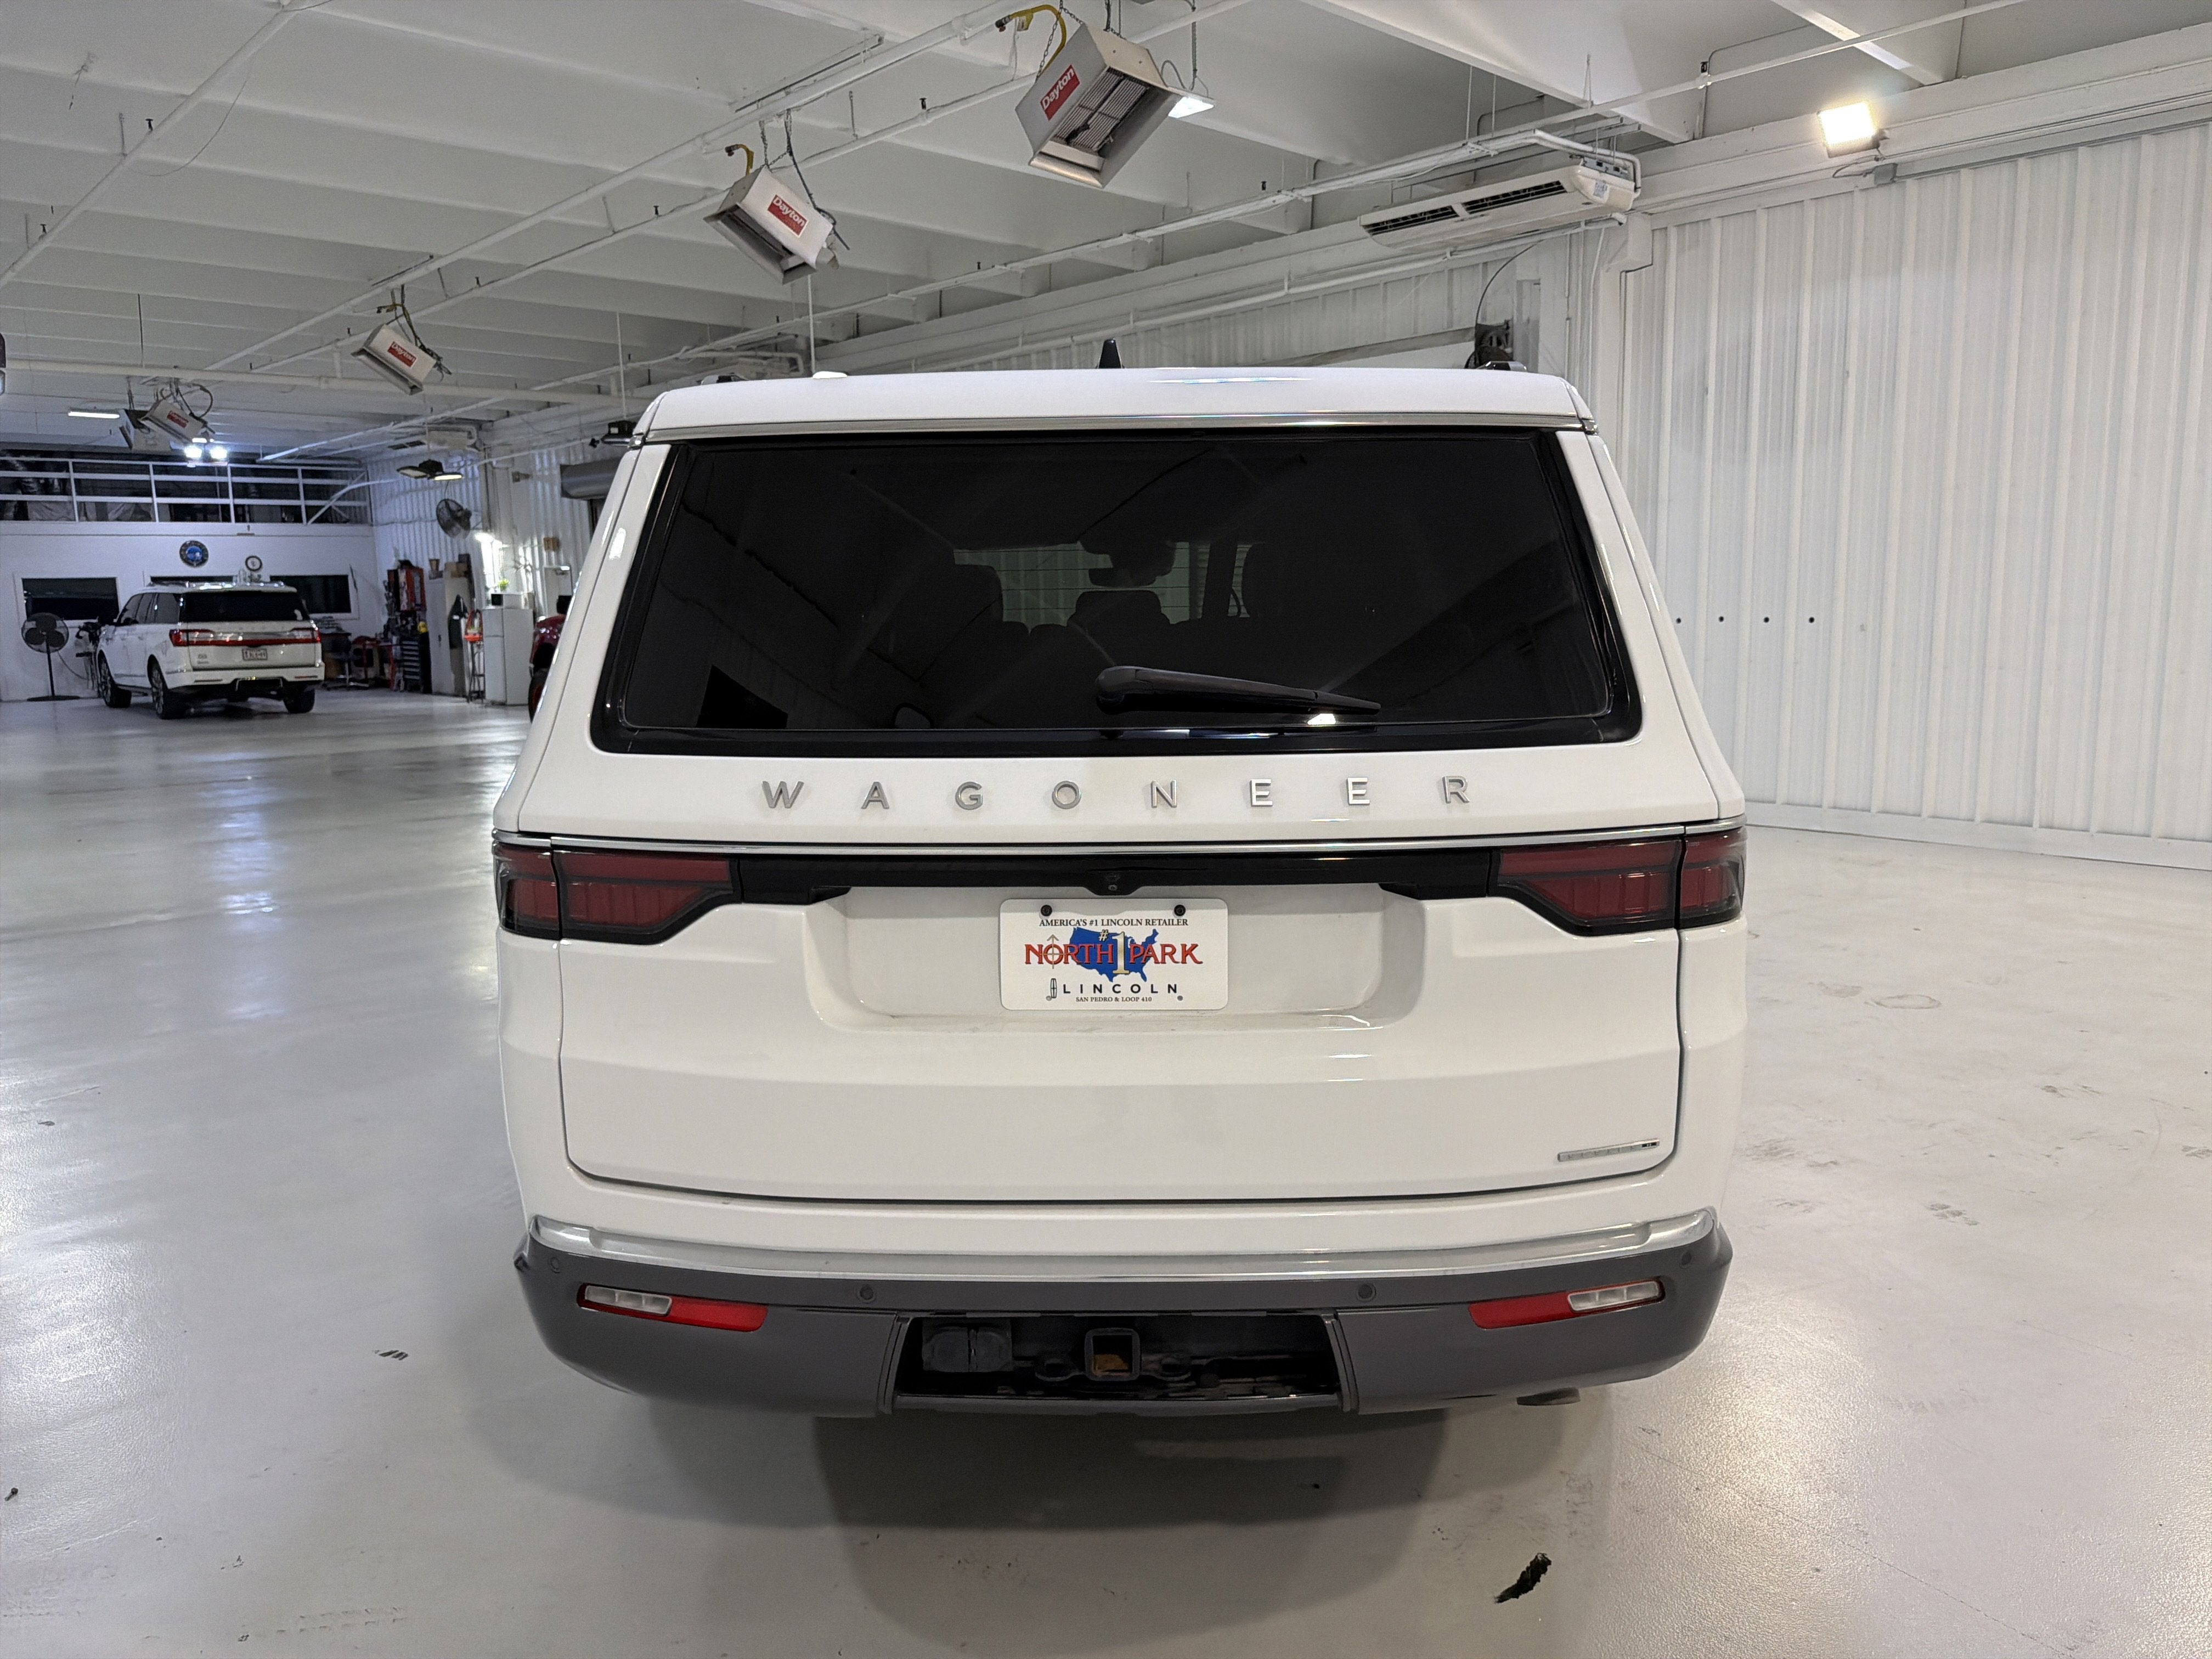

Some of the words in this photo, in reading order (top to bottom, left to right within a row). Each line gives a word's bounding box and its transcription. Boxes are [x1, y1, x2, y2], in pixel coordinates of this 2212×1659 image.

[1042, 67, 1075, 110] Dayton
[773, 196, 806, 227] Dayton
[761, 775, 1470, 810] WAGONEER
[1039, 918, 1087, 927] AMERICA'S
[1025, 943, 1114, 964] NORTH
[1129, 943, 1203, 964] PARK
[1063, 984, 1177, 994] LINCOLN
